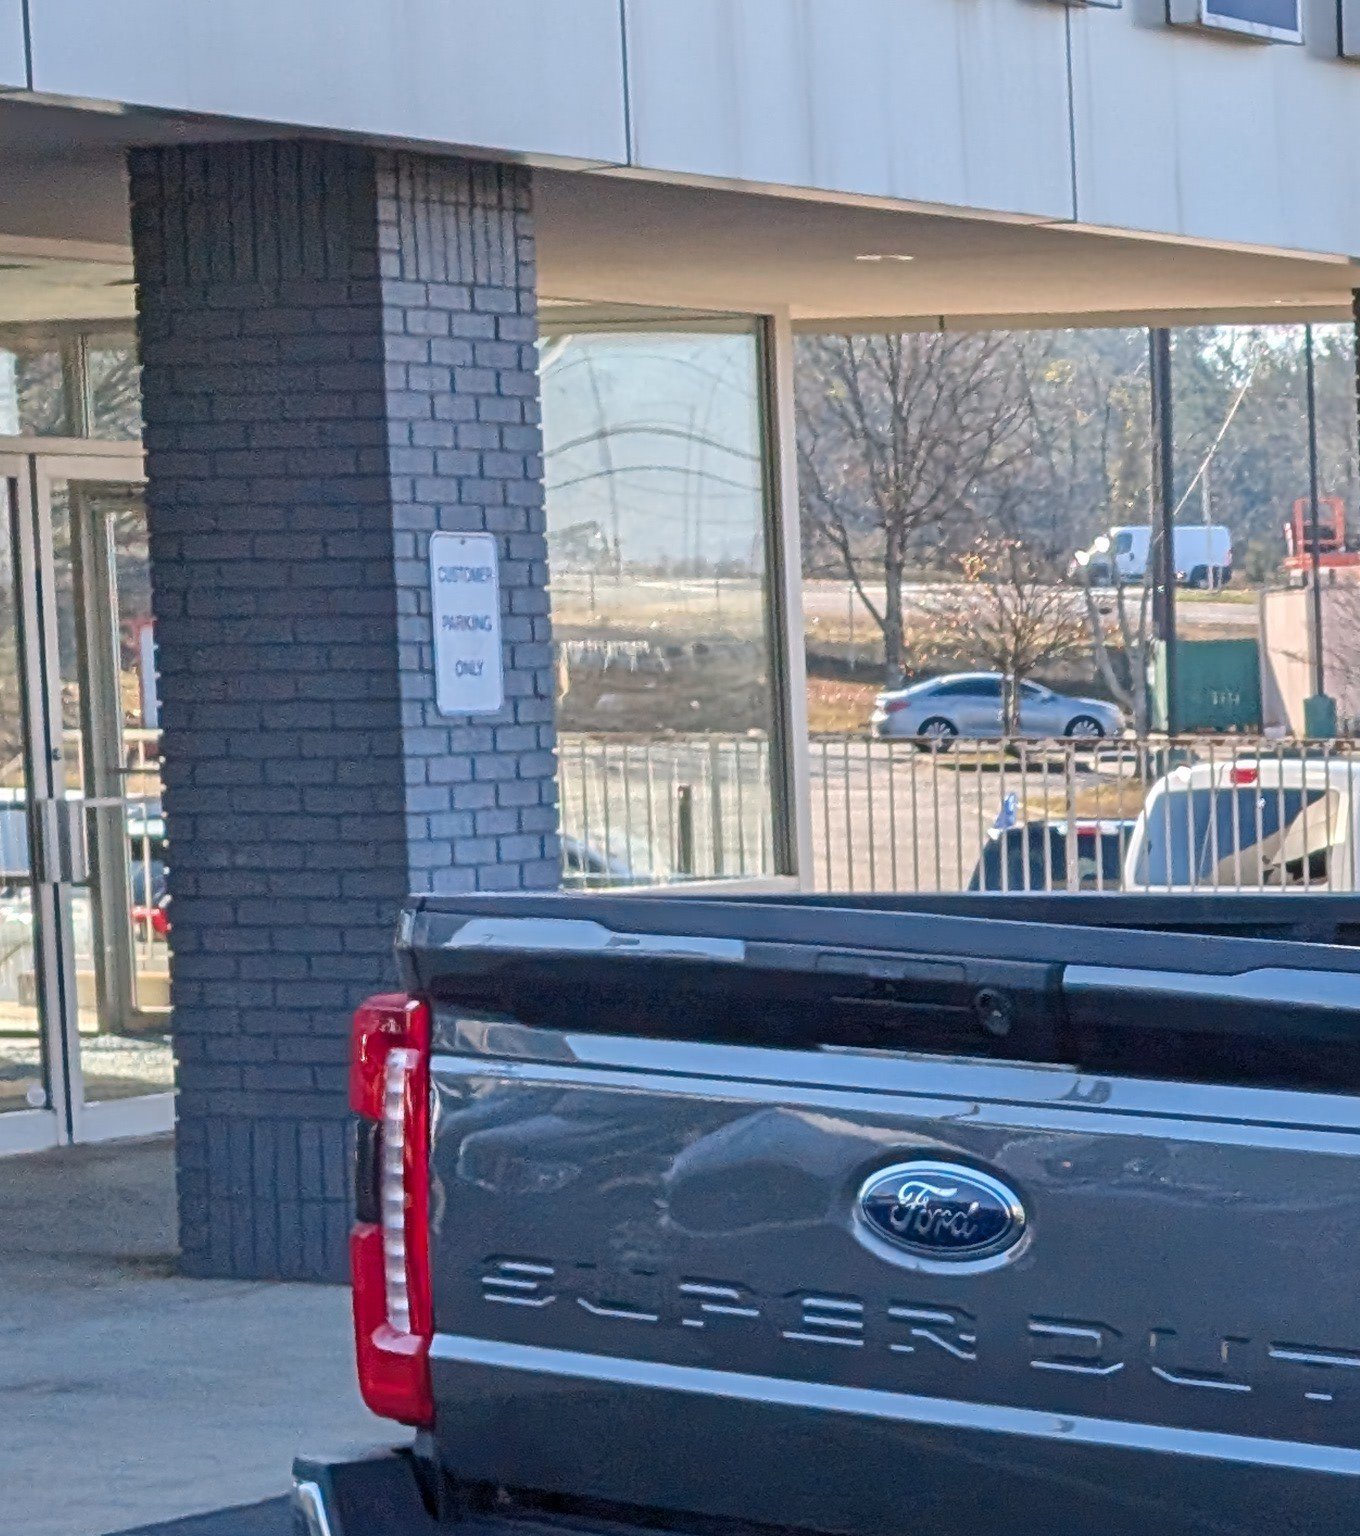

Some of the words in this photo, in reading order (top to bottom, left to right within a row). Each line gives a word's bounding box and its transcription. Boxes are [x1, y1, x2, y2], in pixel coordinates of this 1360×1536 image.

[441, 613, 493, 632] PARKING
[454, 658, 484, 678] ONLY
[889, 1180, 981, 1239] Ford
[481, 1253, 978, 1361] SUPER
